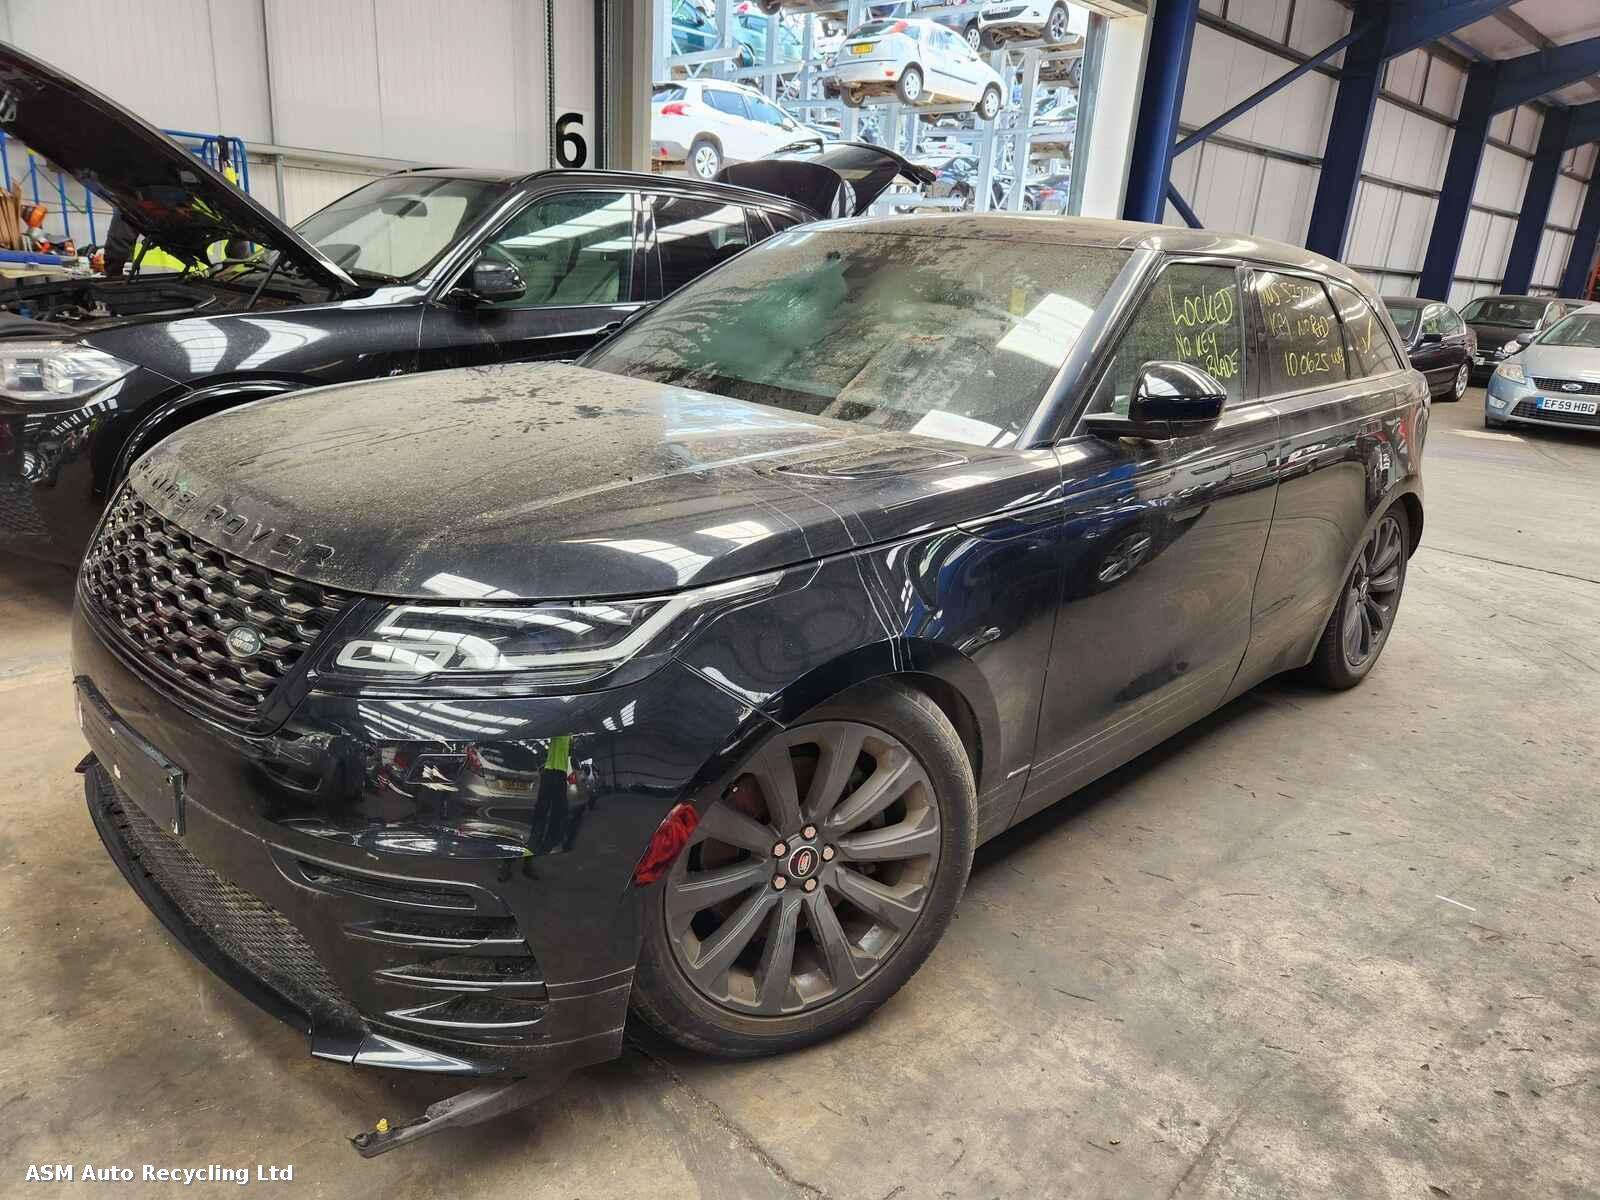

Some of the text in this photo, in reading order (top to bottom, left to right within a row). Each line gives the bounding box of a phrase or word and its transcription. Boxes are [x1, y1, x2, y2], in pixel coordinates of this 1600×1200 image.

[556, 112, 587, 169] 6
[1167, 284, 1234, 326] LOCKED
[1174, 331, 1219, 365] NO KEY
[1205, 348, 1239, 380] BLADE
[1543, 399, 1596, 413] EF59 HBG
[200, 503, 336, 568] ROVER
